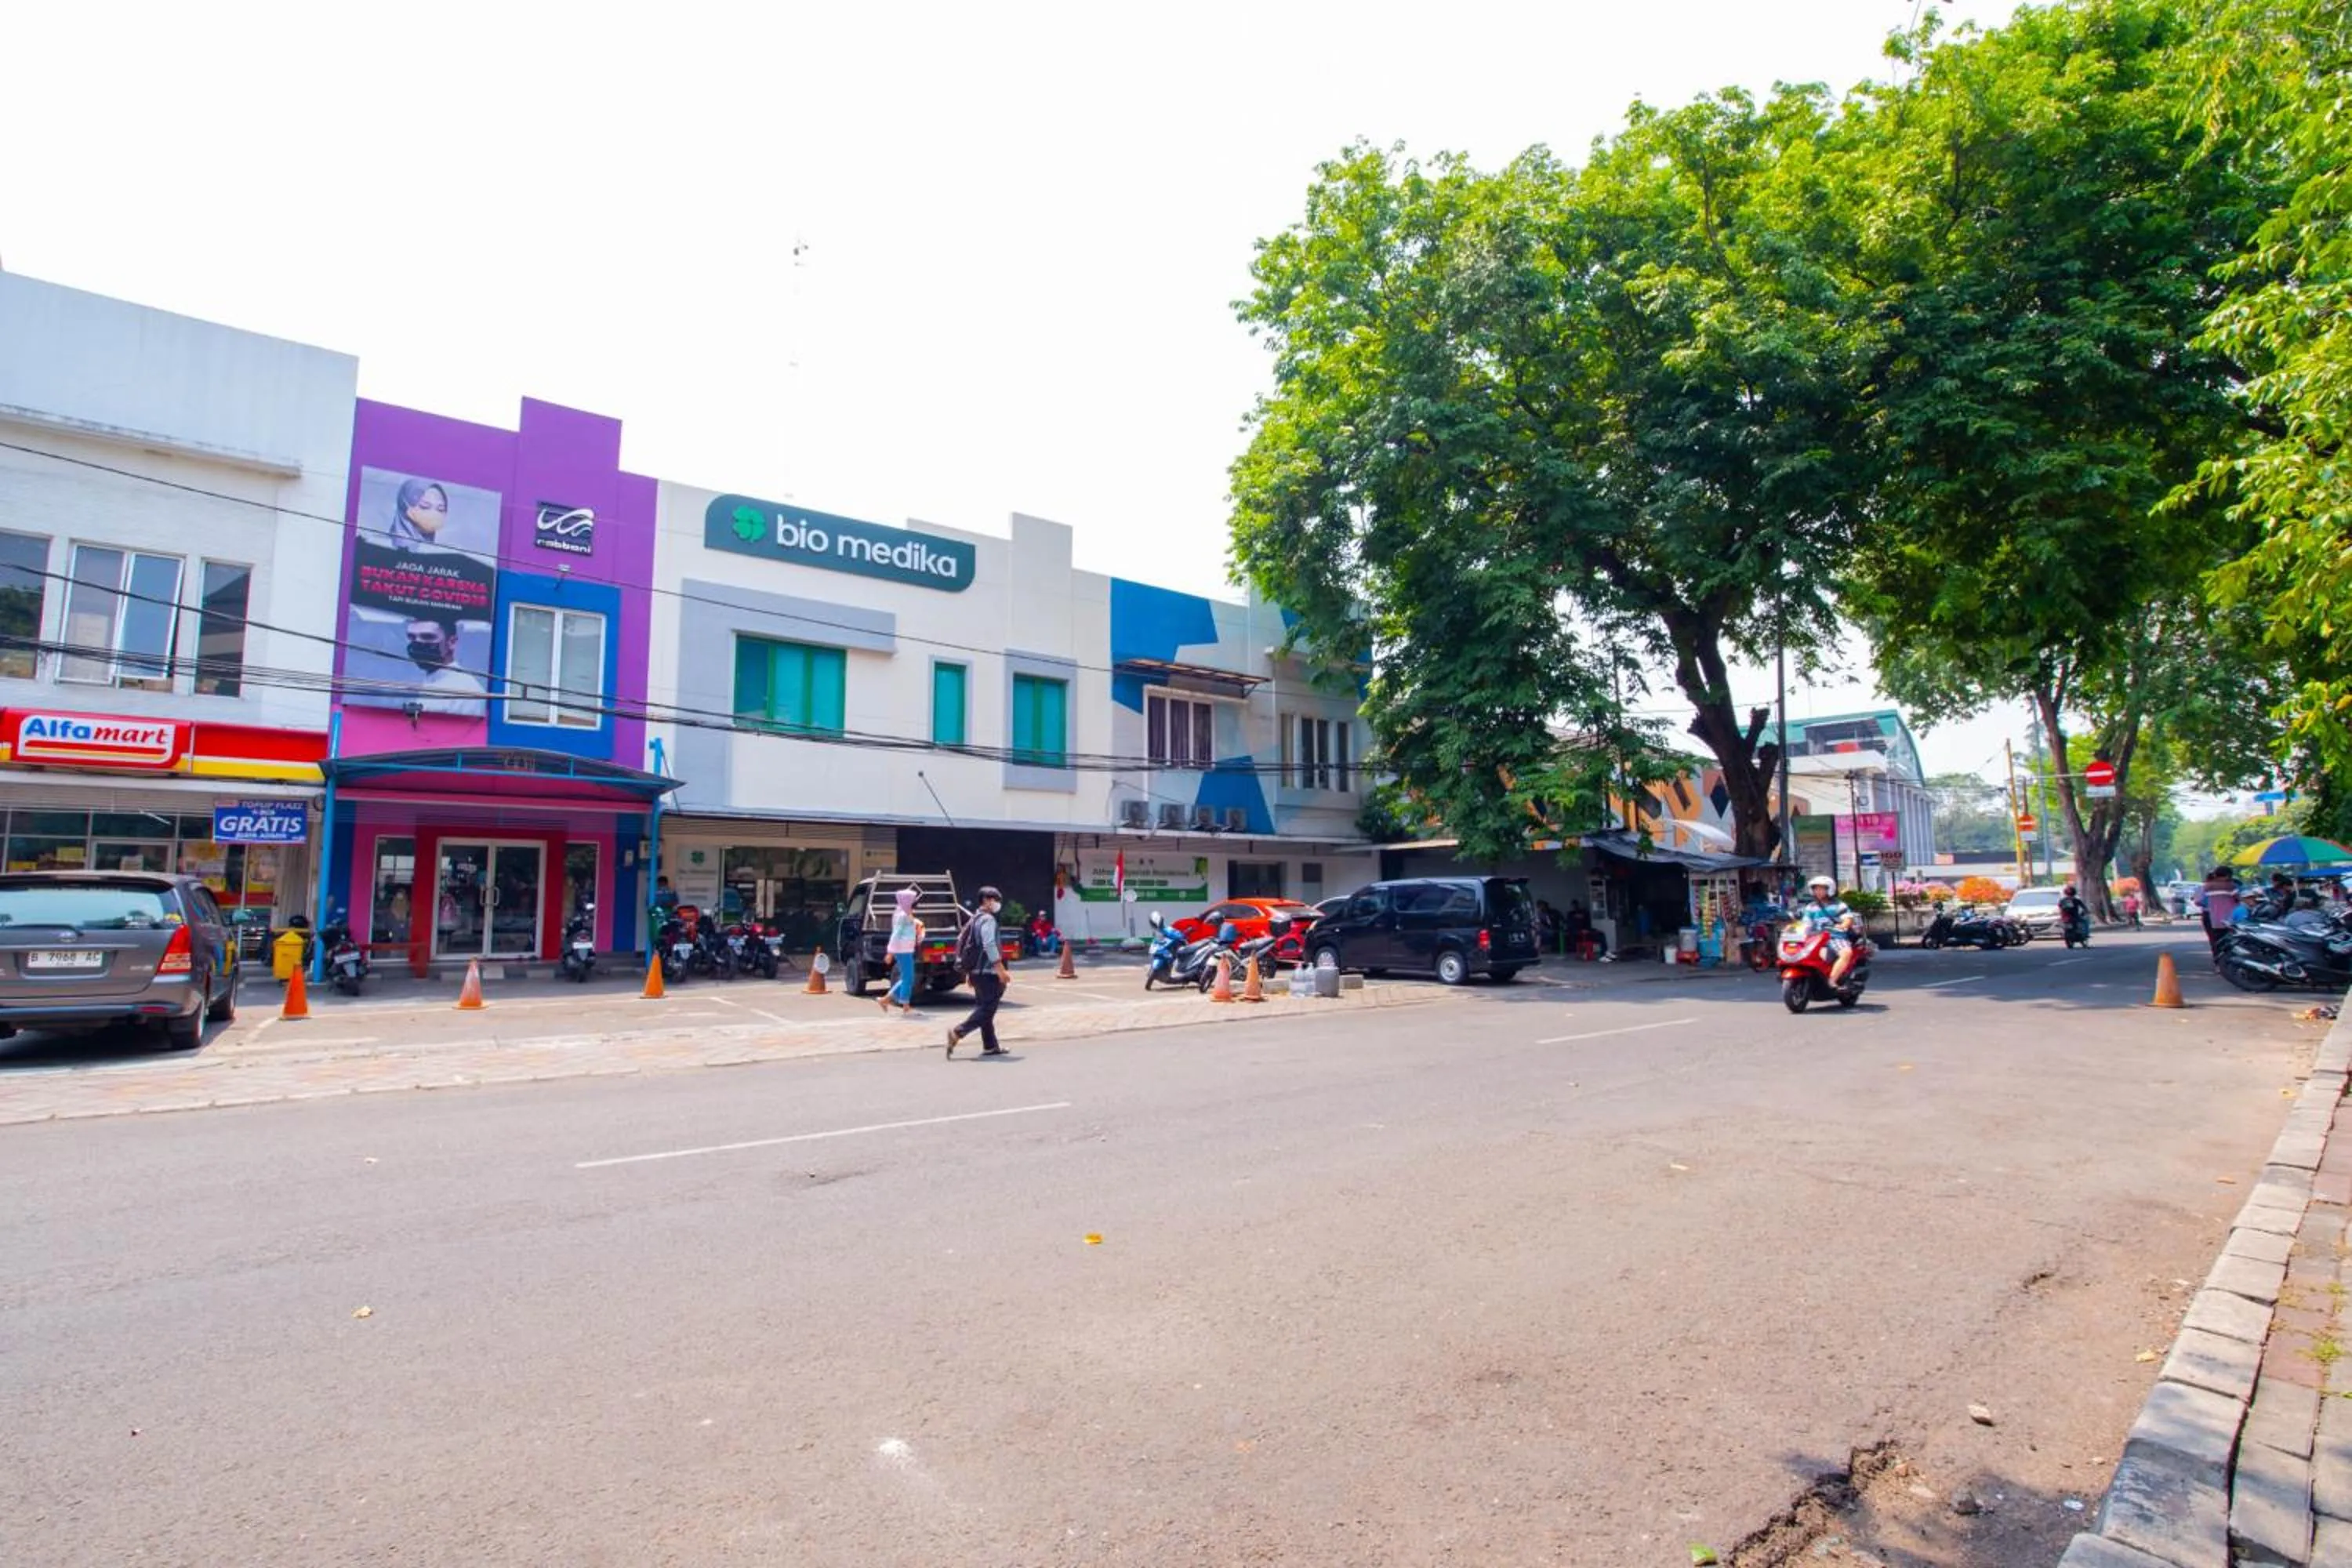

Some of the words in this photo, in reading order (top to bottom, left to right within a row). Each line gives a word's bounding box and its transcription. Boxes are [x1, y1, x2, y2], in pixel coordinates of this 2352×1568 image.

[536, 539, 592, 554] rabbani
[776, 514, 829, 553] bio
[837, 535, 957, 578] medika
[361, 565, 420, 584] BUKAN
[394, 561, 424, 574] JAGA
[427, 565, 461, 579] JARAK
[361, 579, 418, 597] TAKUT
[24, 717, 169, 745] Alfamart
[219, 815, 303, 833] GRATIS
